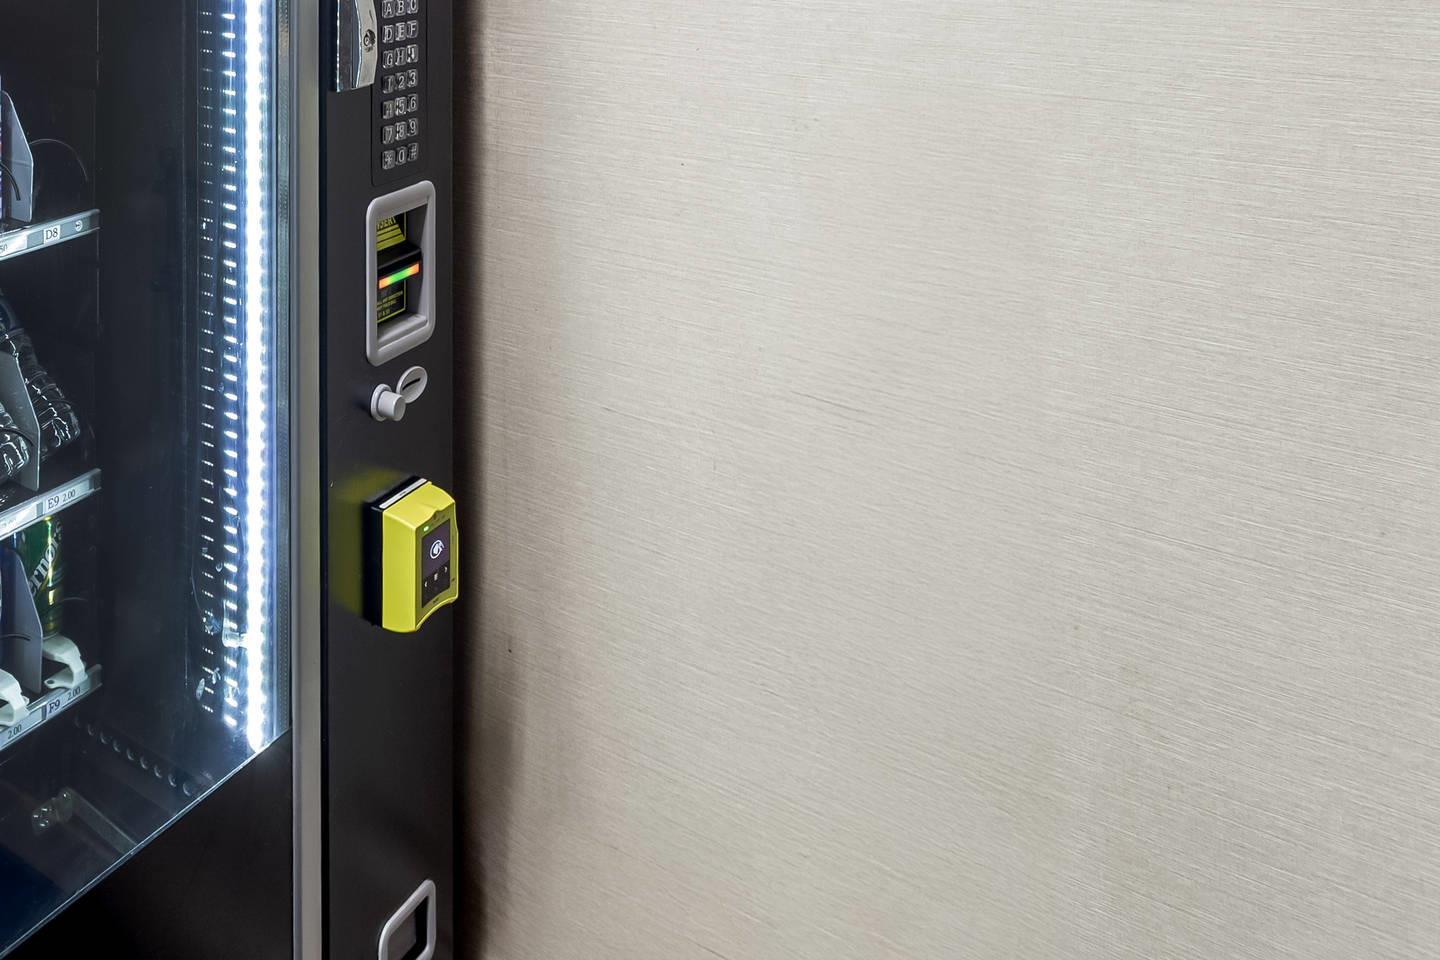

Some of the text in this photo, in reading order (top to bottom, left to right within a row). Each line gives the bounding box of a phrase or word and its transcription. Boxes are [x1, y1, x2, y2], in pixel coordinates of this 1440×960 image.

[45, 227, 58, 240] D8
[47, 489, 76, 510] E9 2.00
[48, 685, 81, 714] F9 2.00
[8, 723, 22, 740] 2.00
